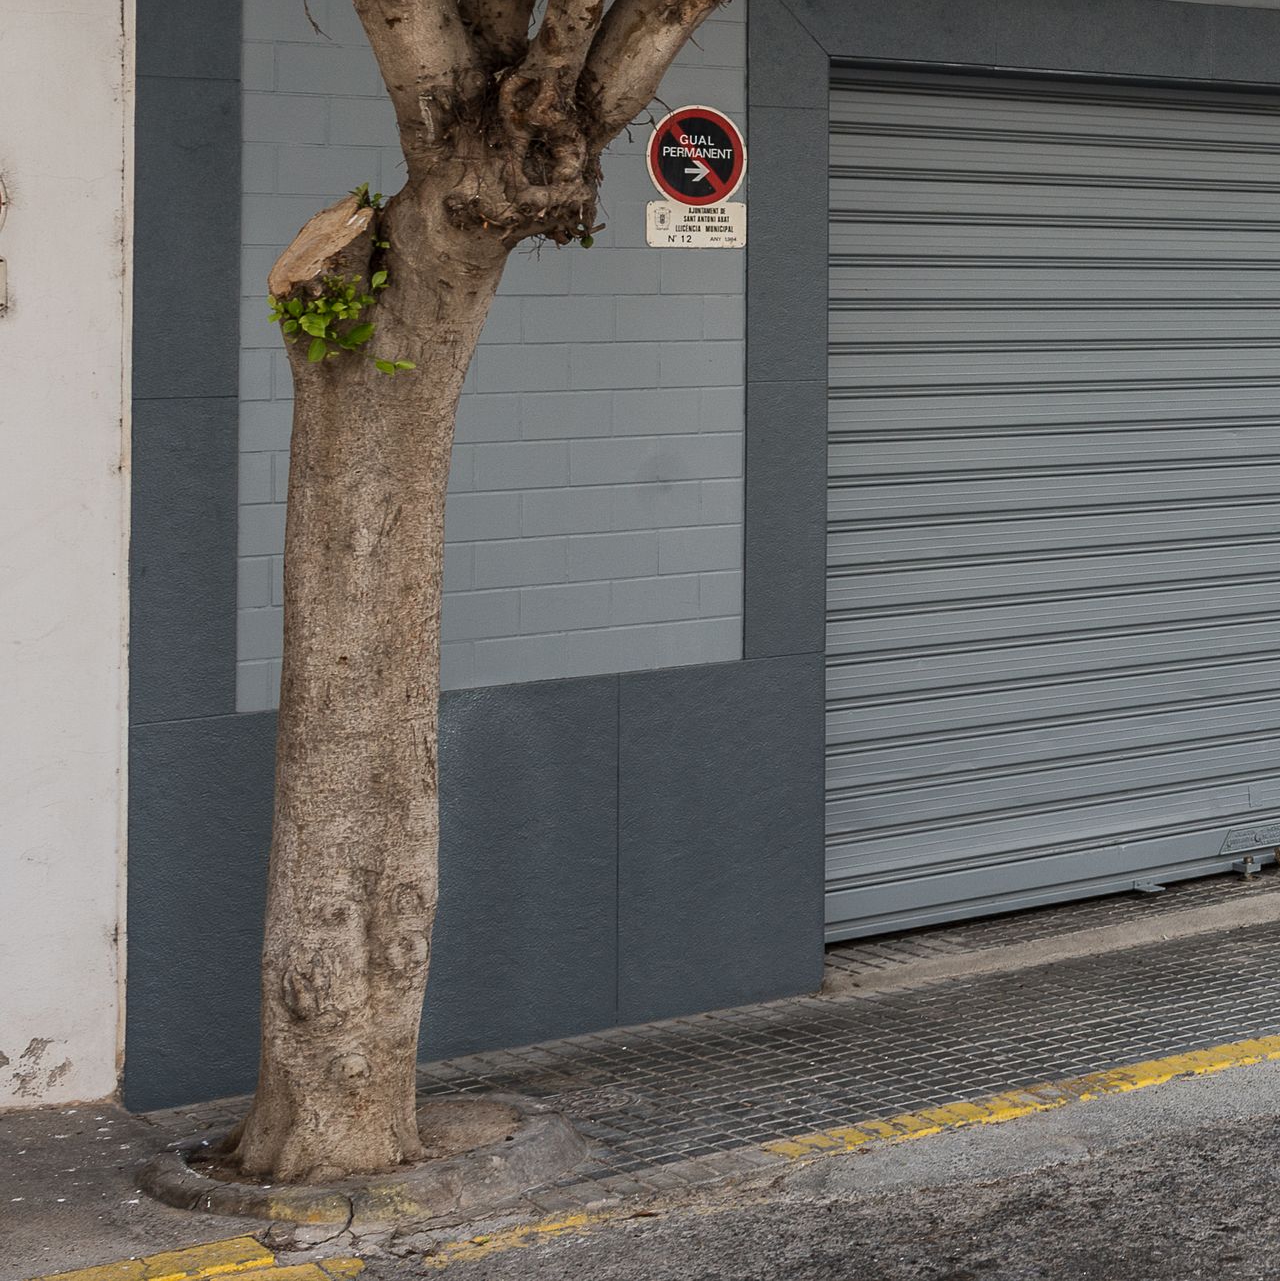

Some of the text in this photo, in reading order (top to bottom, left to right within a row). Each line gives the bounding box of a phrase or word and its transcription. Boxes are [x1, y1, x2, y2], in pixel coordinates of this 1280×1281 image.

[679, 134, 714, 146] GUAL
[662, 146, 733, 159] PERMANENT
[705, 225, 734, 233] MUNICIPAL
[681, 235, 692, 243] 12
